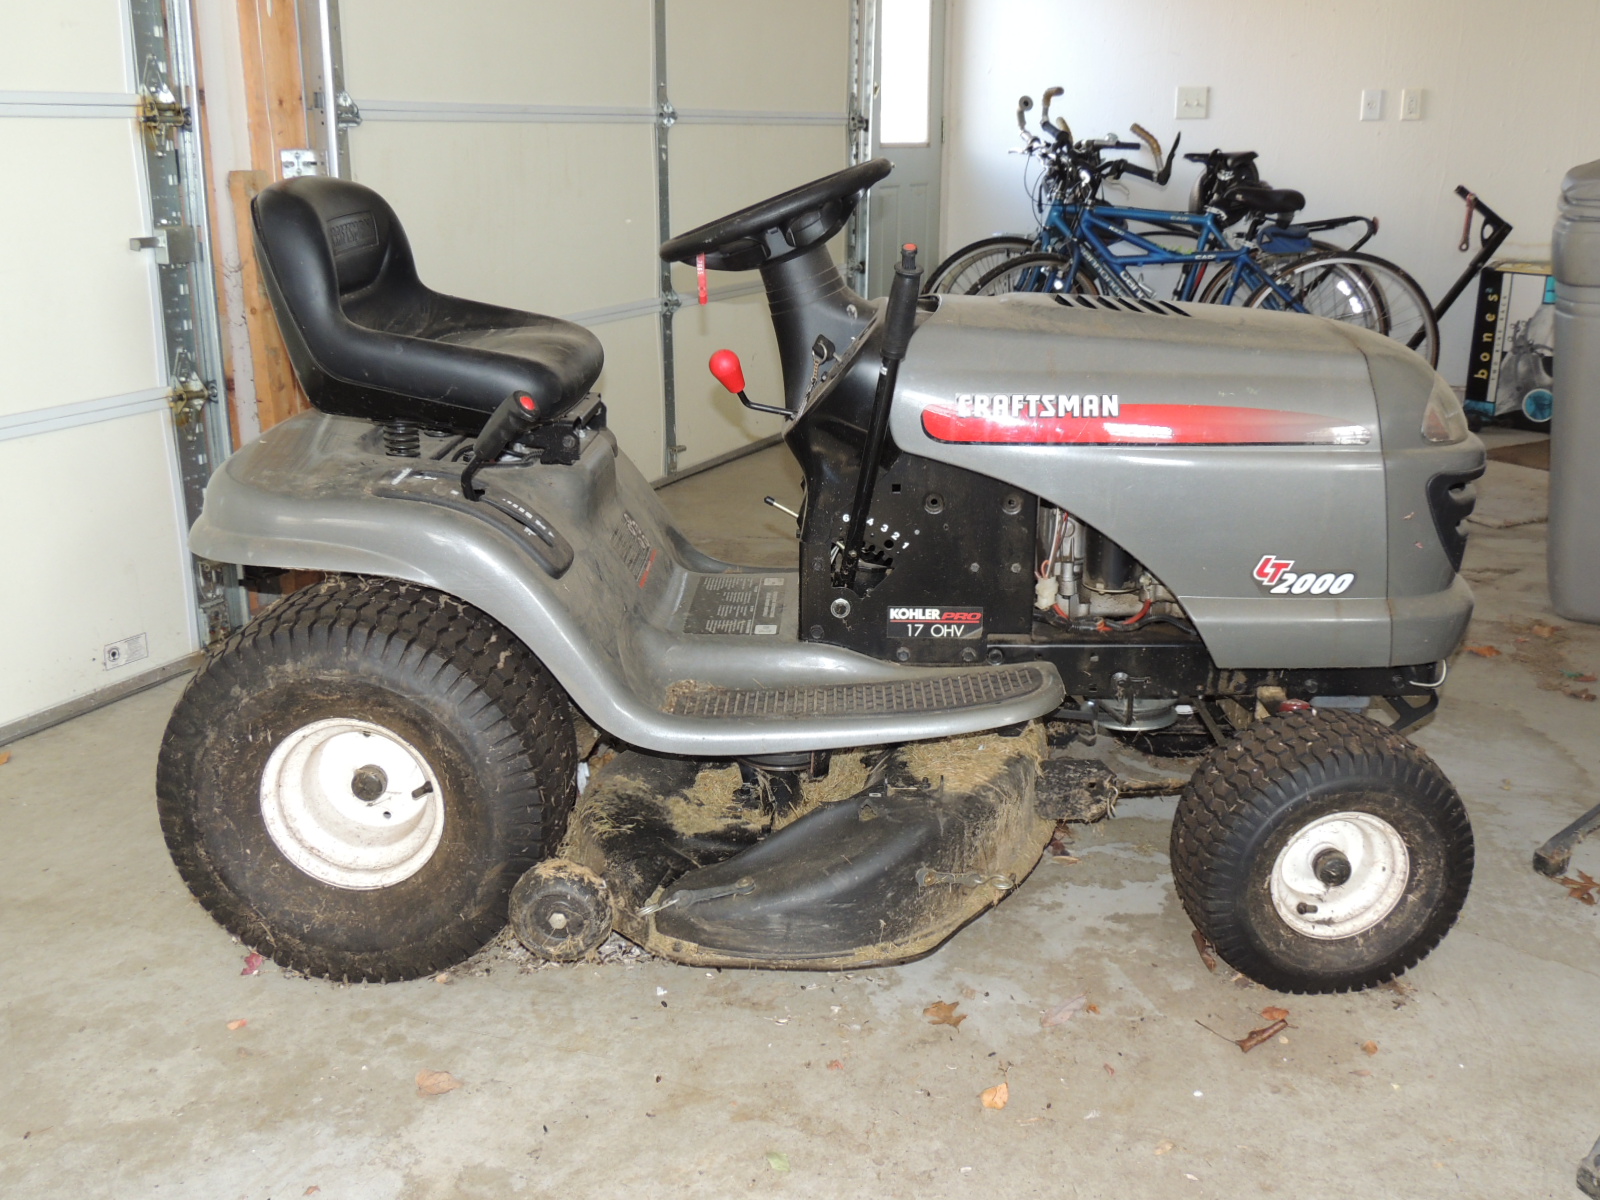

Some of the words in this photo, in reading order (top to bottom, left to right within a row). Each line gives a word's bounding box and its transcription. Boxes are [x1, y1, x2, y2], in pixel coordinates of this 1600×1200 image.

[1474, 294, 1498, 380] bones
[957, 394, 1119, 418] CRAFTSMAN
[842, 514, 850, 522] 6
[866, 518, 874, 526] 4
[881, 524, 889, 532] 3
[891, 531, 900, 540] 2
[1253, 555, 1295, 585] LT
[1270, 573, 1355, 595] 2000
[890, 608, 940, 620] KOHLER
[941, 612, 982, 620] PRO
[907, 624, 924, 637] 17
[930, 624, 965, 637] OHV
